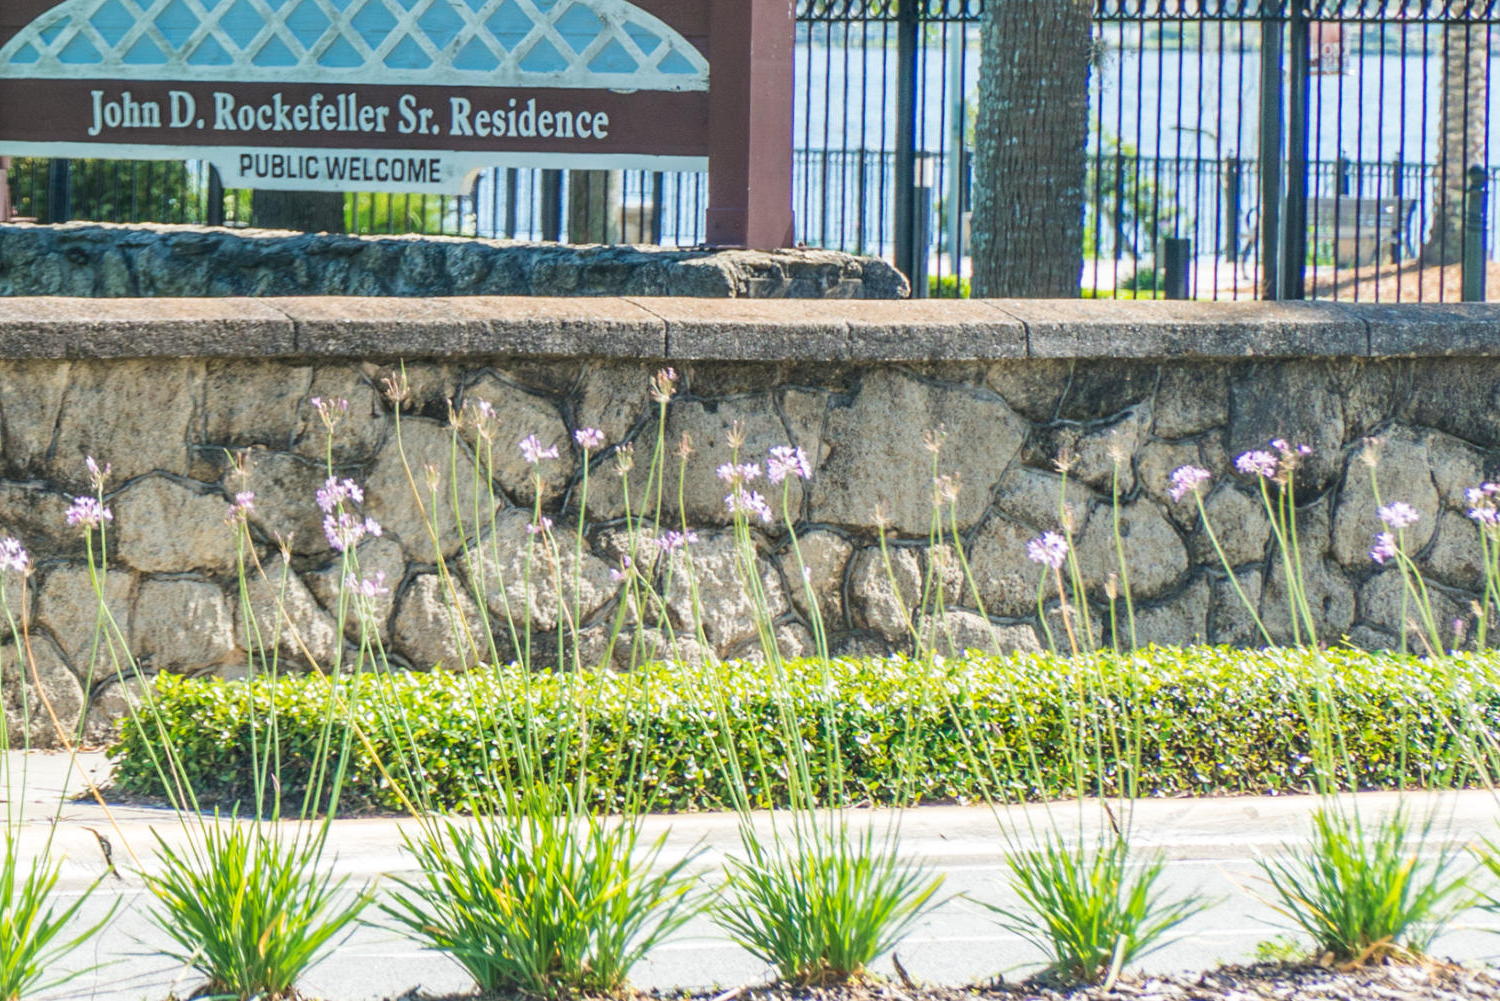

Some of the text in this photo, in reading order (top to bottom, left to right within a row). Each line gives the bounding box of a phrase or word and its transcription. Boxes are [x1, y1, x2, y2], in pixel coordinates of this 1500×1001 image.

[88, 90, 609, 139] John D. Rockefeller Sr. Residence
[240, 154, 441, 182] PUBLIC WELCOME
